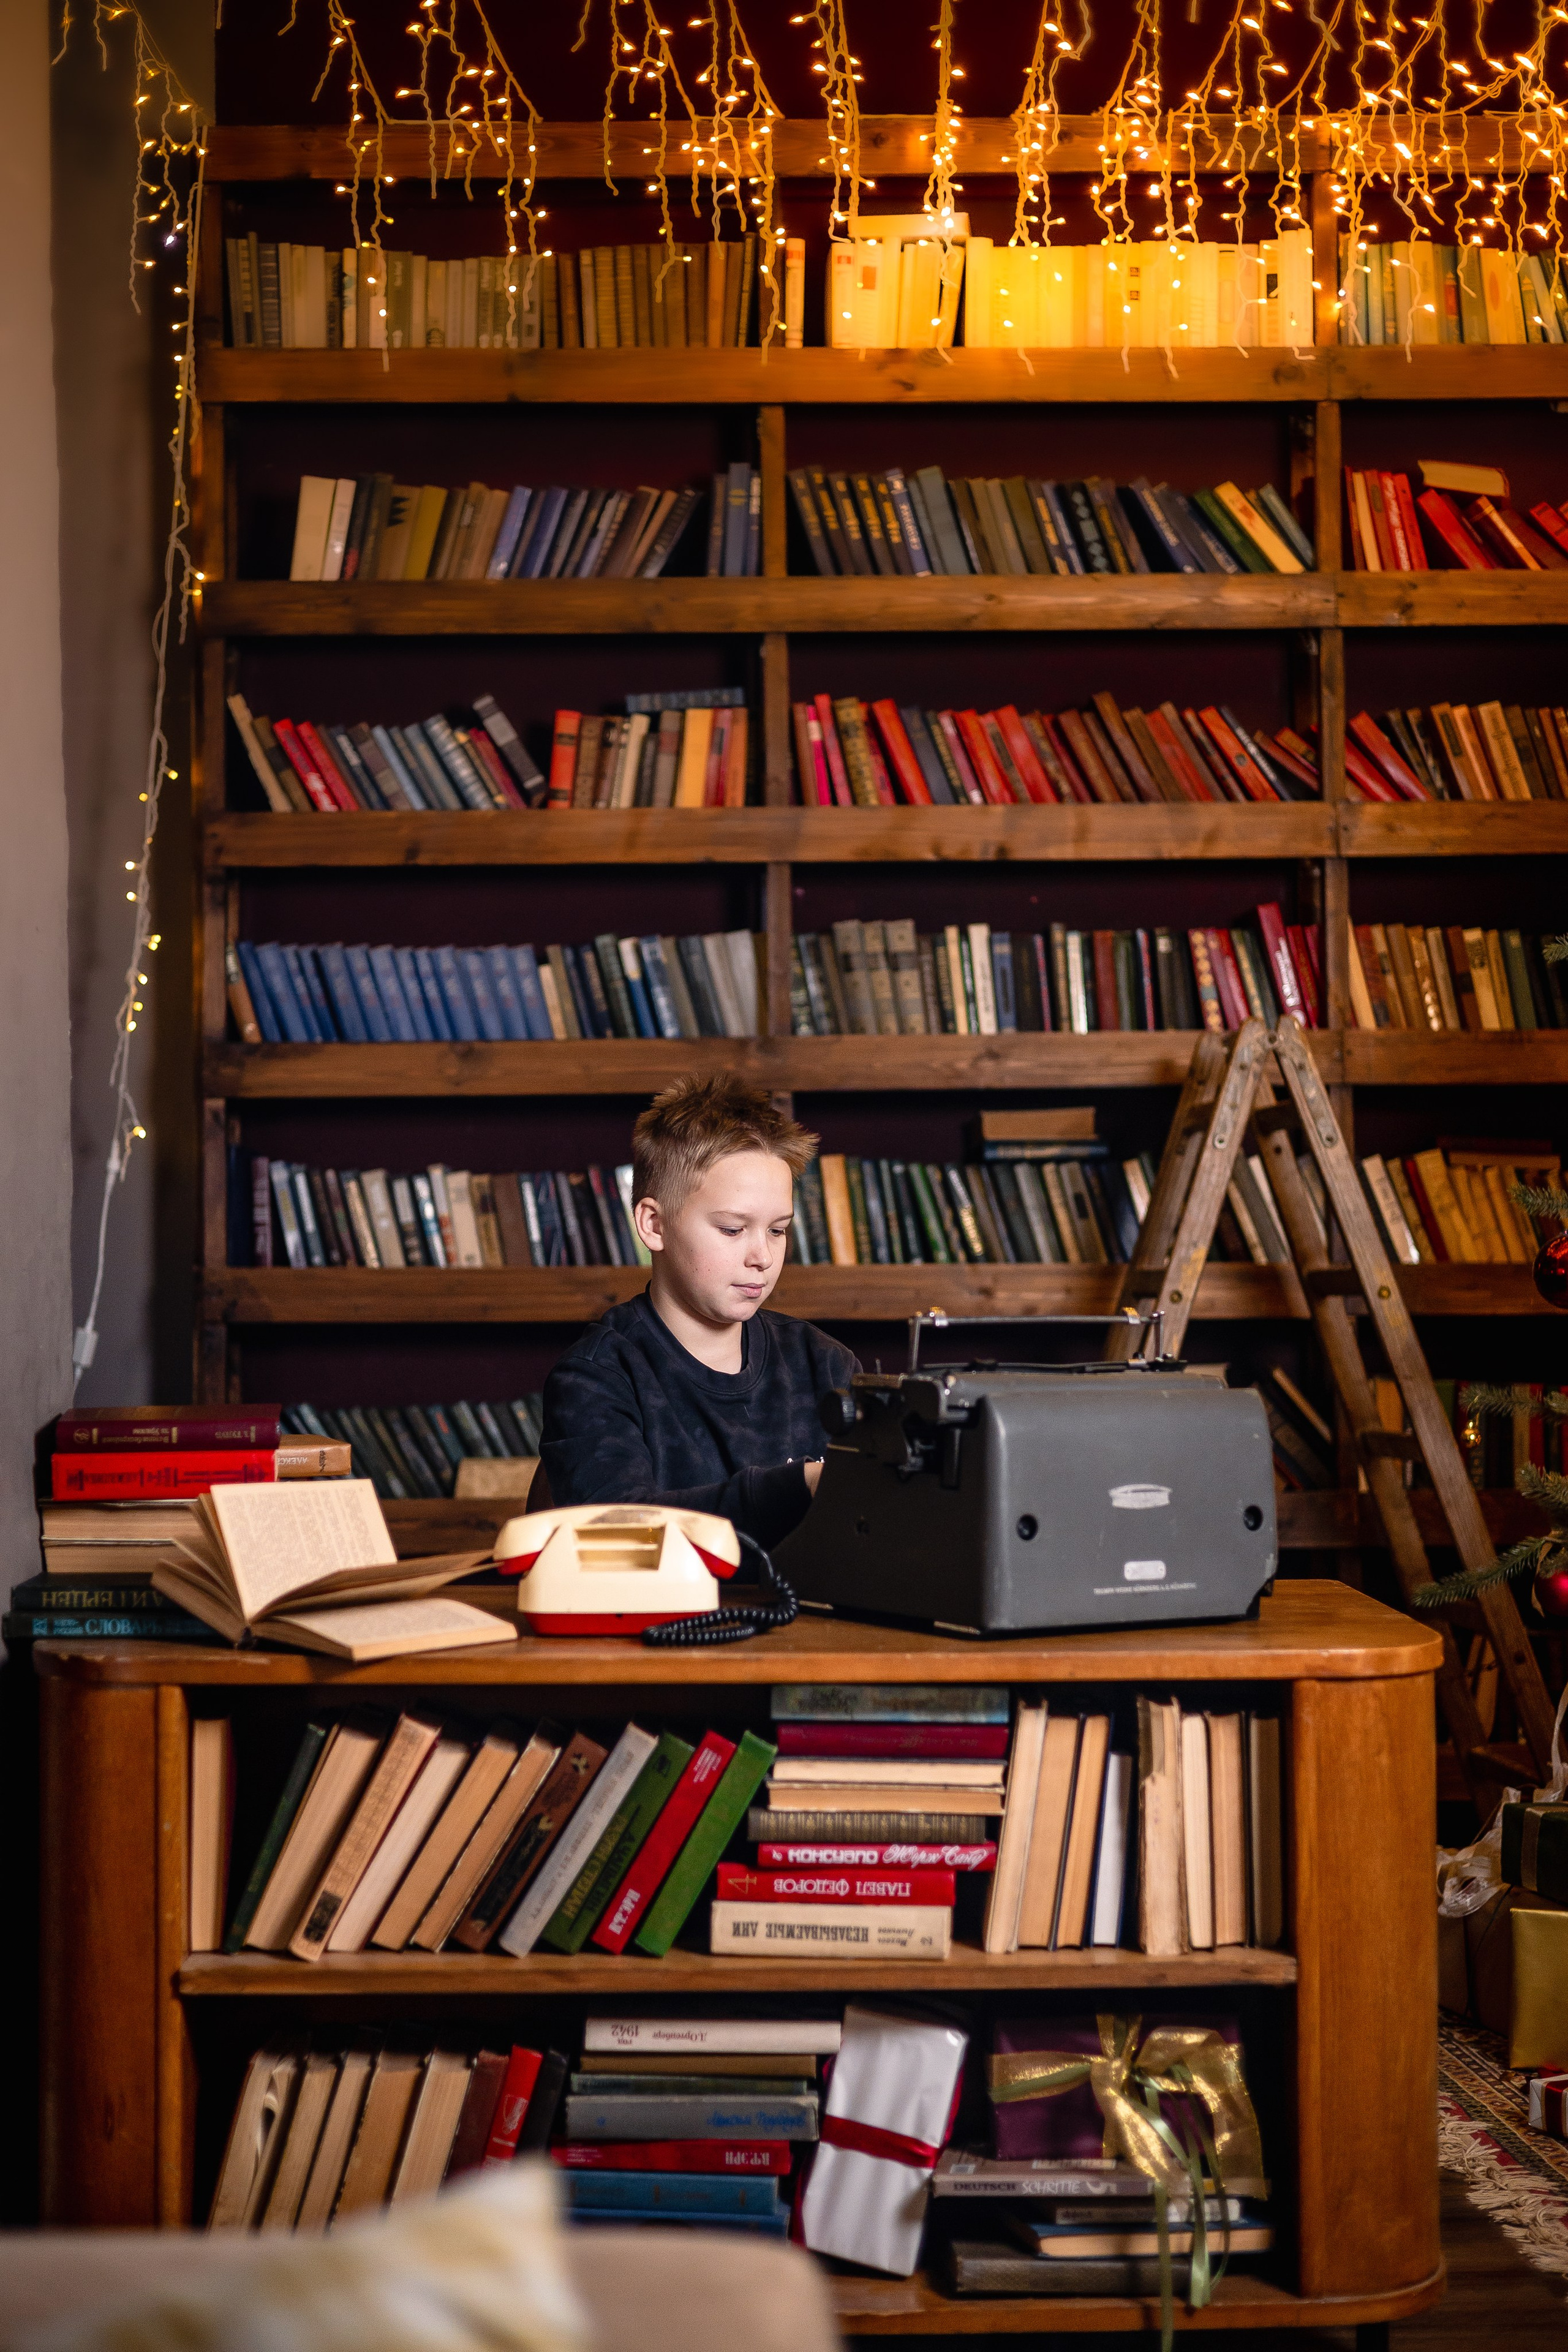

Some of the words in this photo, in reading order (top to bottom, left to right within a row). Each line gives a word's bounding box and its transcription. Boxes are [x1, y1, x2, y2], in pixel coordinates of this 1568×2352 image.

[41, 1590, 127, 1608] ГЕРЦЕН
[774, 1878, 850, 1896] ФЕДОРОВ
[855, 1881, 911, 1897] ПАВЕЛ
[732, 1921, 759, 1938] ДНИ
[766, 1922, 869, 1943] НЕЗАБЫВАЕМЫЕ
[611, 2024, 640, 2037] 1942
[954, 2181, 1017, 2192] DEUTSCH
